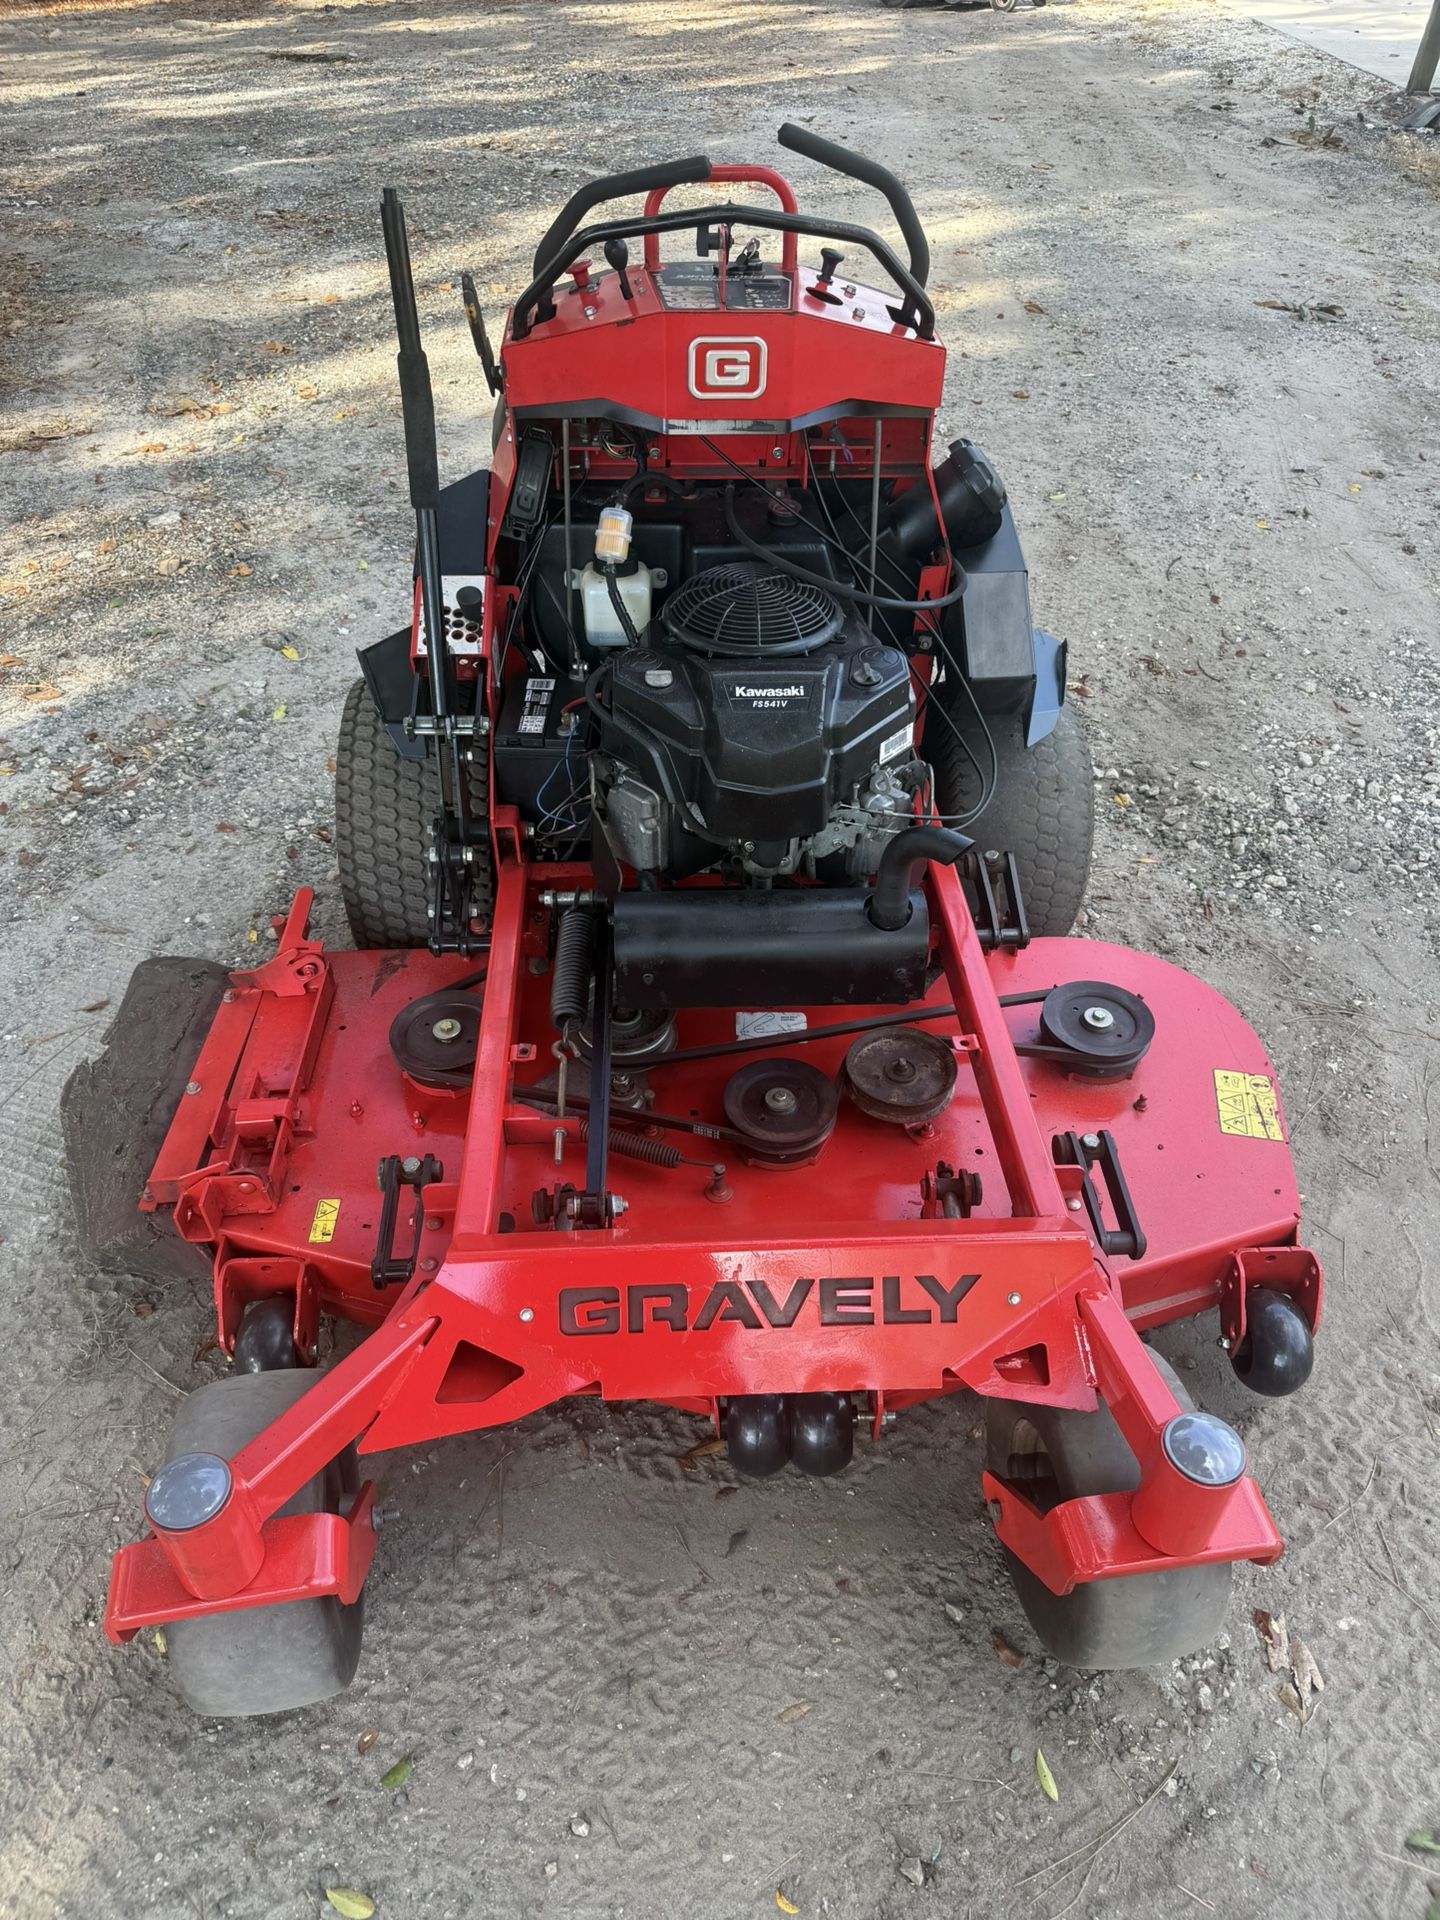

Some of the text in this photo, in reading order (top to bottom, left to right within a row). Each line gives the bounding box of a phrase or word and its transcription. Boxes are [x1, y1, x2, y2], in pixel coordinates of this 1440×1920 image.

[705, 350, 750, 386] G
[735, 685, 805, 697] Kawasaki
[752, 700, 788, 708] FS541V
[558, 1273, 983, 1337] GRAVELY
